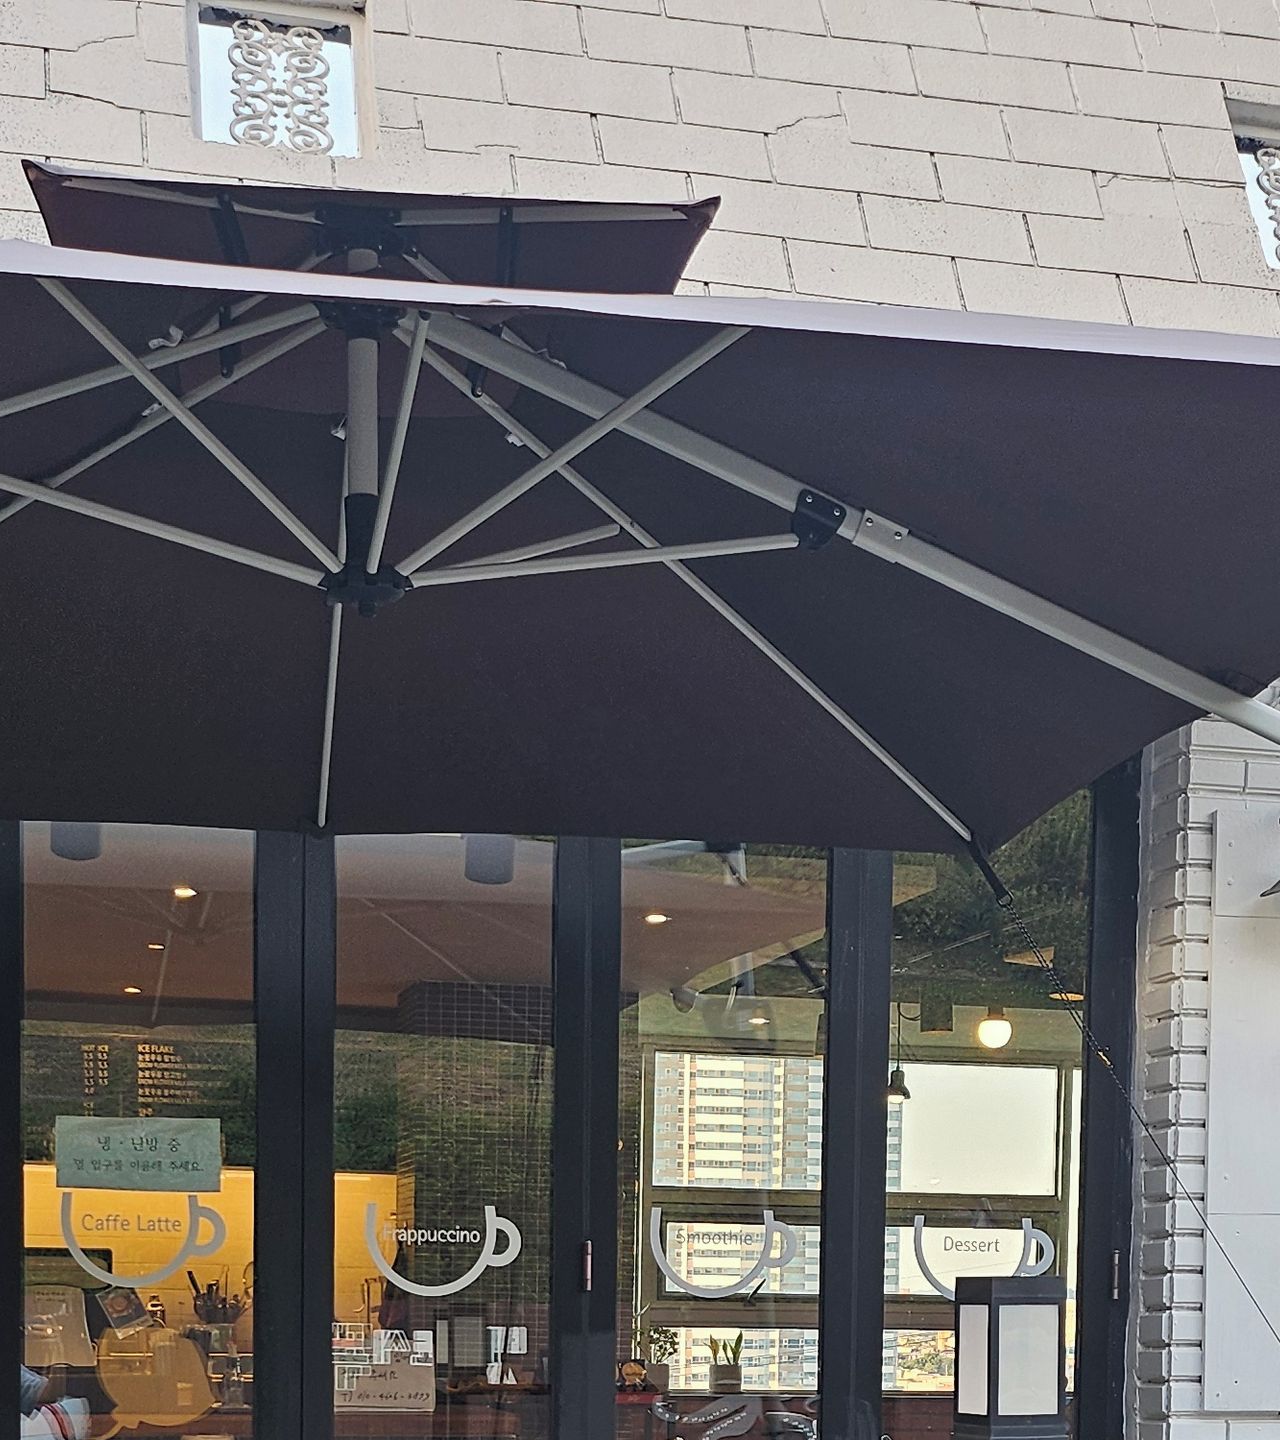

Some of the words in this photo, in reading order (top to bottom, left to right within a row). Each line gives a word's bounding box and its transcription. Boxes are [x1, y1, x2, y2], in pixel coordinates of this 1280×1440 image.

[130, 1135, 158, 1152] 난방
[167, 1137, 182, 1152] 중
[81, 1213, 131, 1231] Caffe
[136, 1214, 182, 1232] Latte
[383, 1222, 481, 1246] Frappuccino
[675, 1227, 754, 1246] Smoothie
[943, 1235, 1001, 1253] Dessert
